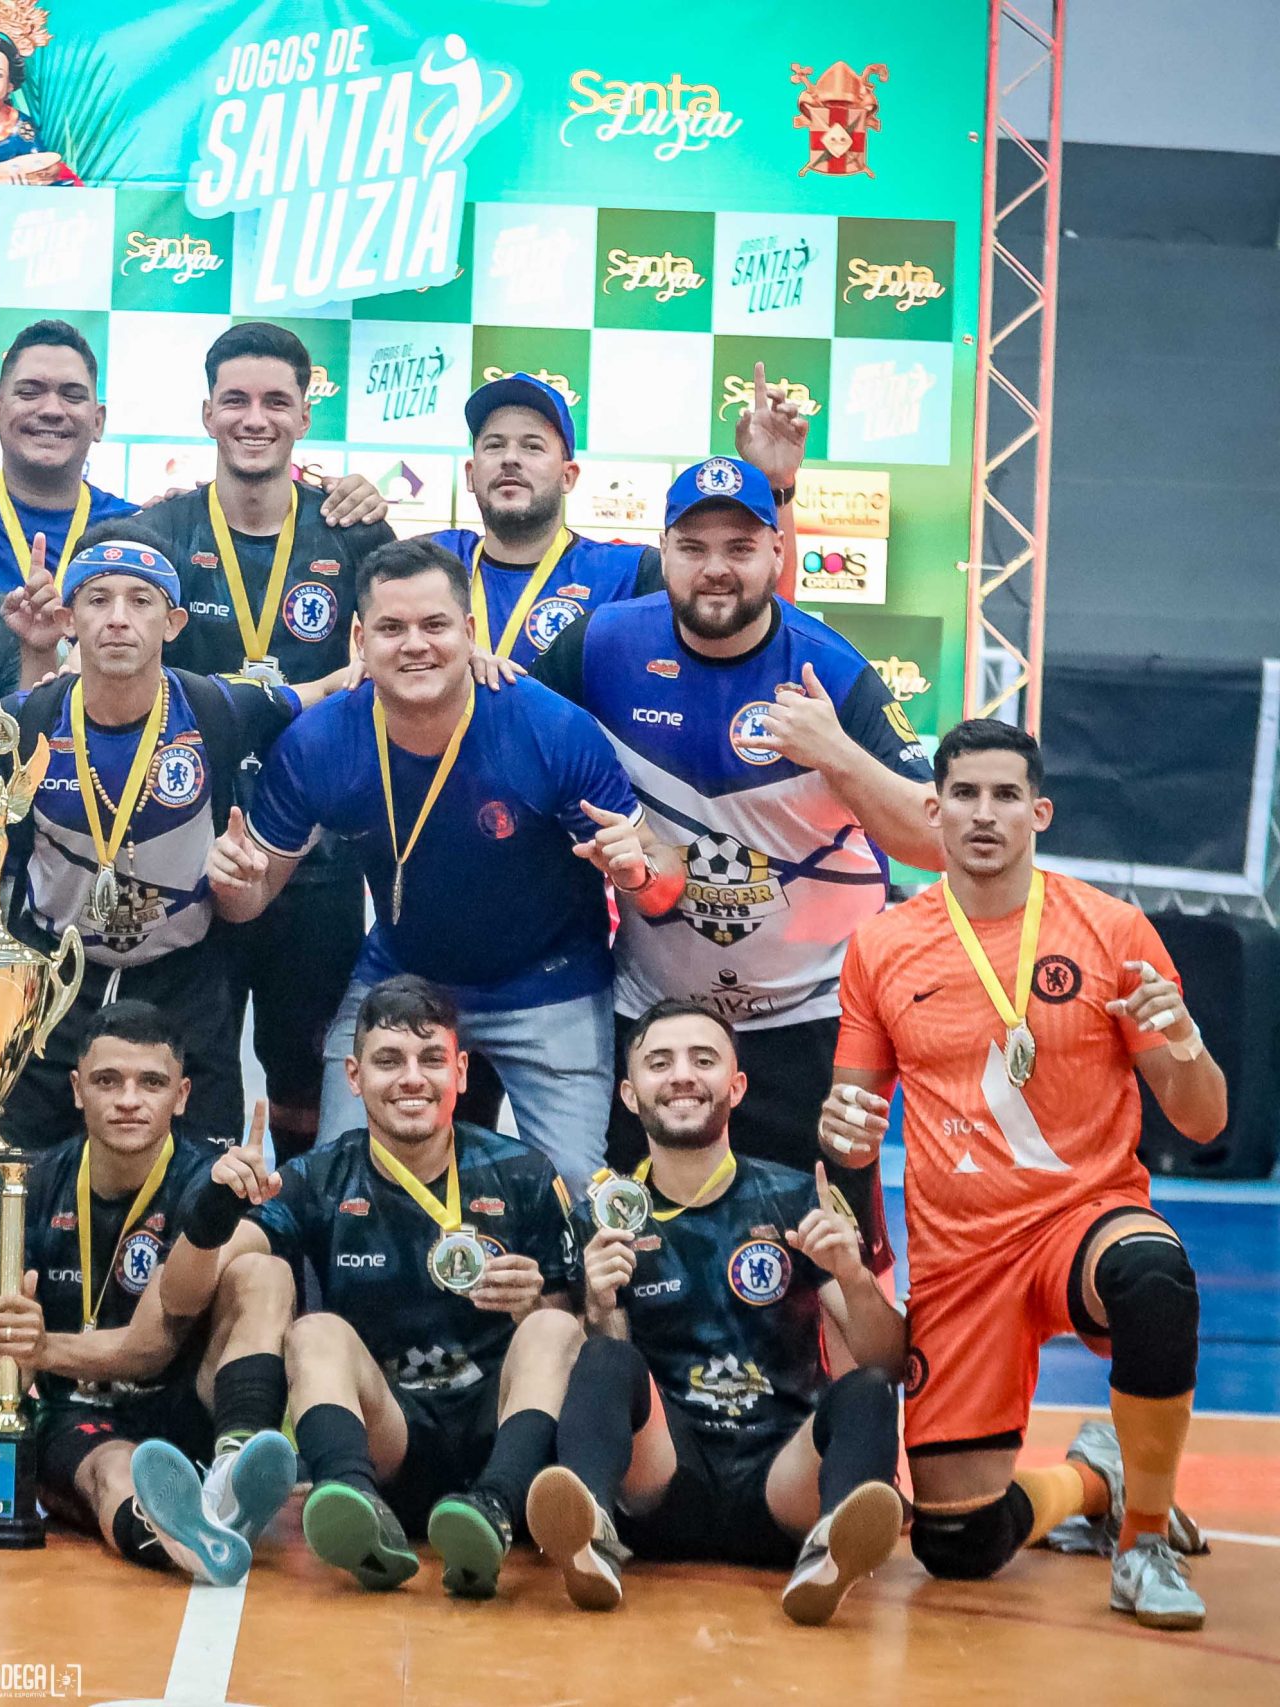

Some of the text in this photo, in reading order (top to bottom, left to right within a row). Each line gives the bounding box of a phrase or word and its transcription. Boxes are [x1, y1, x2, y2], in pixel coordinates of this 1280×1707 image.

[215, 25, 369, 96] JOGOS DE
[568, 69, 721, 118] Santa
[559, 81, 744, 162] Luzia
[195, 71, 414, 208] SANTA
[126, 230, 212, 258] Santa
[253, 169, 457, 304] LUZIA
[607, 248, 695, 277] Santa
[731, 248, 791, 287] SANTA
[847, 257, 935, 285] Santa
[747, 277, 803, 313] LUZIA
[365, 356, 427, 394] SANTA
[382, 385, 440, 422] LUZIA
[295, 586, 332, 602] CHELSEA
[541, 602, 579, 615] CHELSEA
[686, 882, 774, 905] OCCER
[695, 903, 751, 917] BETS
[125, 1235, 159, 1251] CHELSEA
[740, 1243, 781, 1261] CHELSEA
